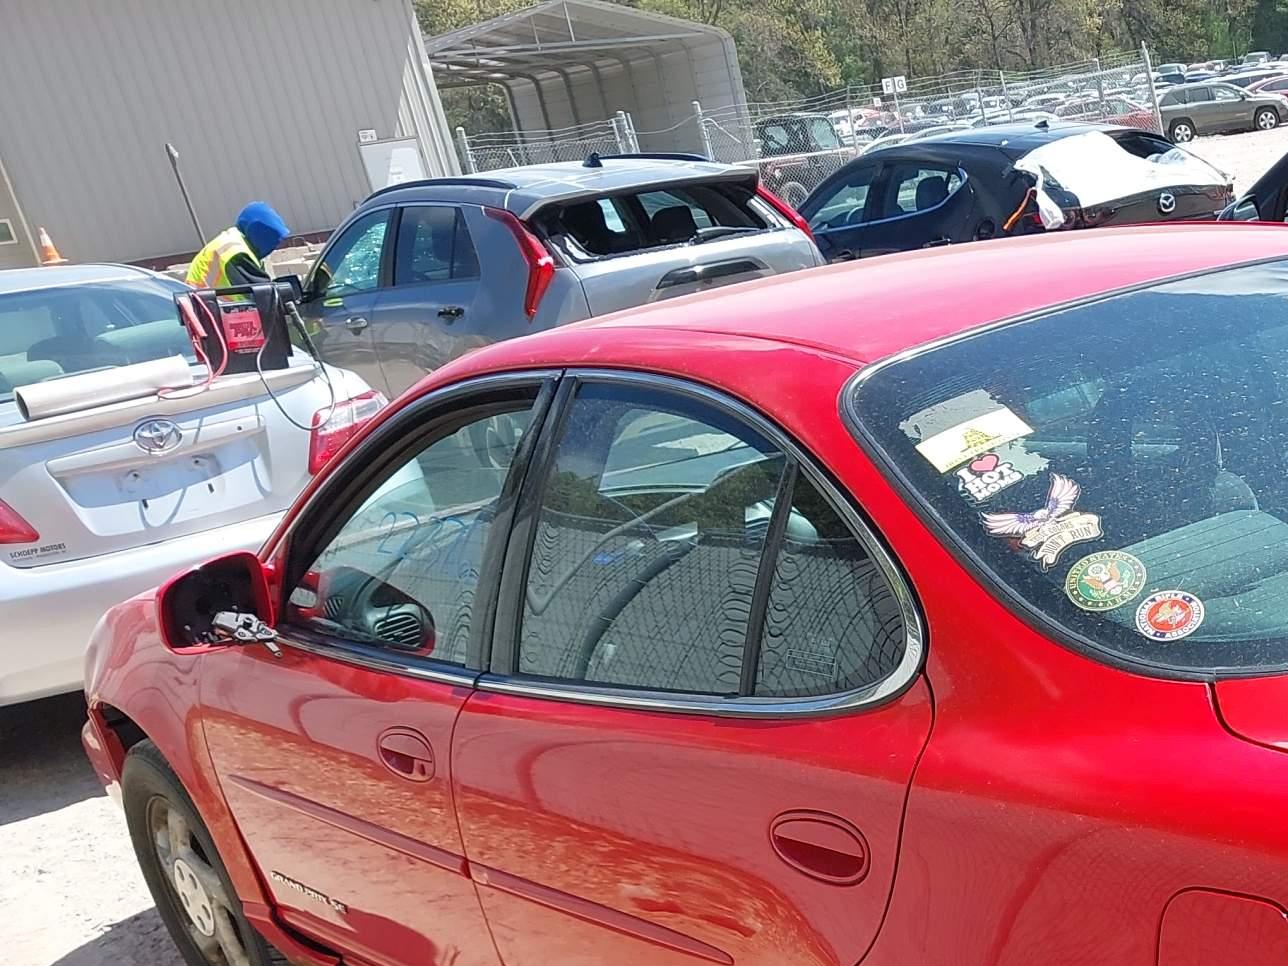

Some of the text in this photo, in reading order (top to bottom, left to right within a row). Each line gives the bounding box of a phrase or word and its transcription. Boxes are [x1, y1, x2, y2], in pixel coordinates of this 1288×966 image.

[885, 81, 891, 90] F
[897, 80, 905, 89] G
[965, 463, 1012, 492] HOT
[1069, 526, 1092, 540] RUN
[40, 543, 66, 552] MOTORS
[1069, 556, 1089, 589] UNITED
[1106, 585, 1138, 607] ARMY
[1138, 593, 1201, 638] NATIONAL RIFLE ASSOCIATION
